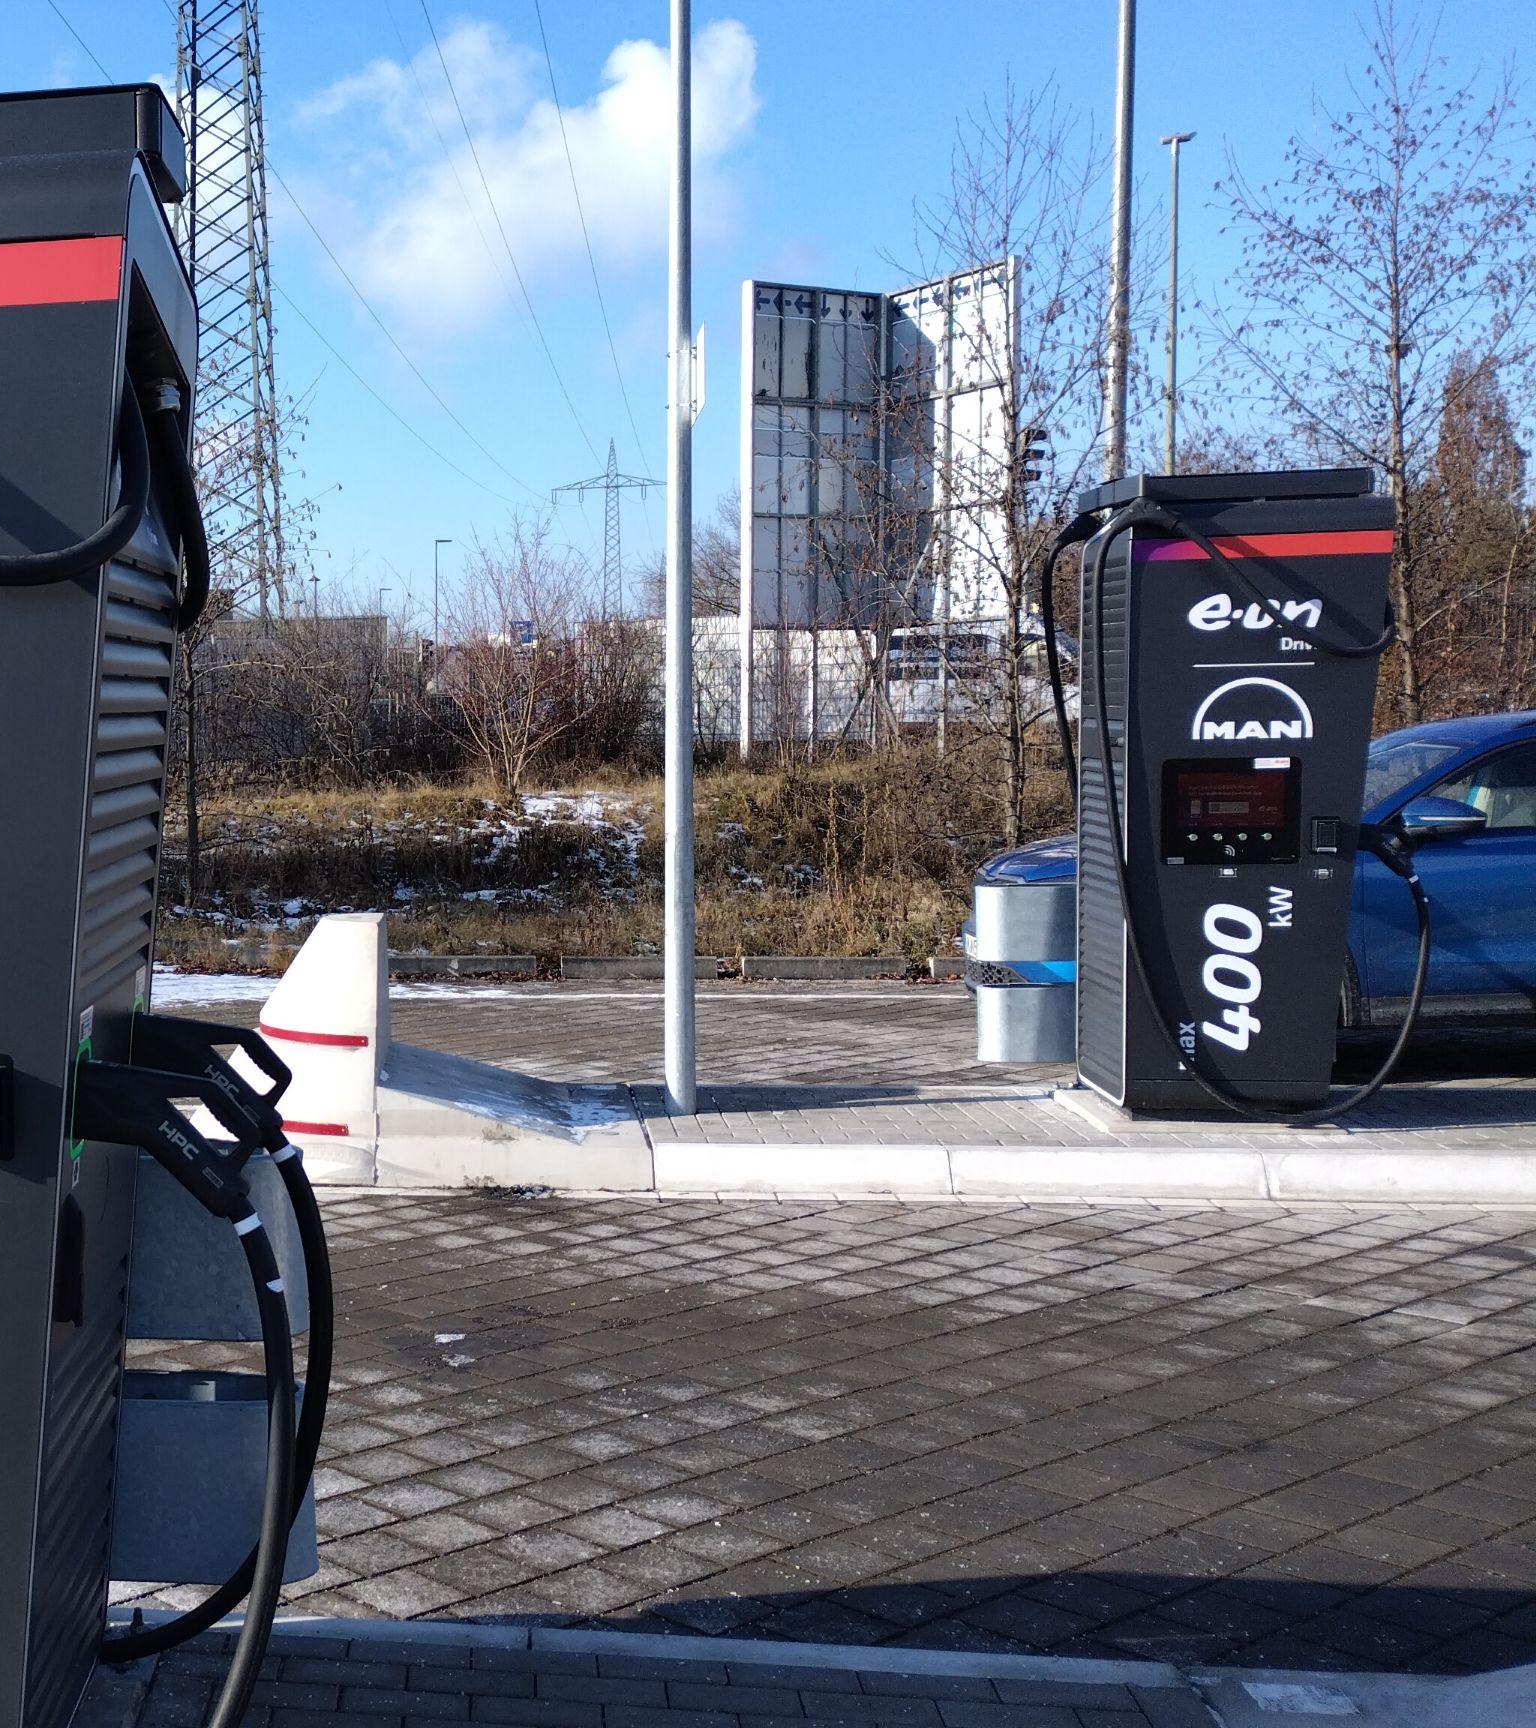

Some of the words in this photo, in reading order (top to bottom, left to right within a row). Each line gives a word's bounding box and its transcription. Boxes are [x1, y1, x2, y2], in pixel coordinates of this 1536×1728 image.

[1280, 636, 1317, 651] Driv
[1202, 720, 1303, 740] MAN
[1267, 885, 1293, 927] kW
[1202, 904, 1263, 1051] 400
[204, 1064, 239, 1097] HPC
[158, 1120, 199, 1160] HPC
